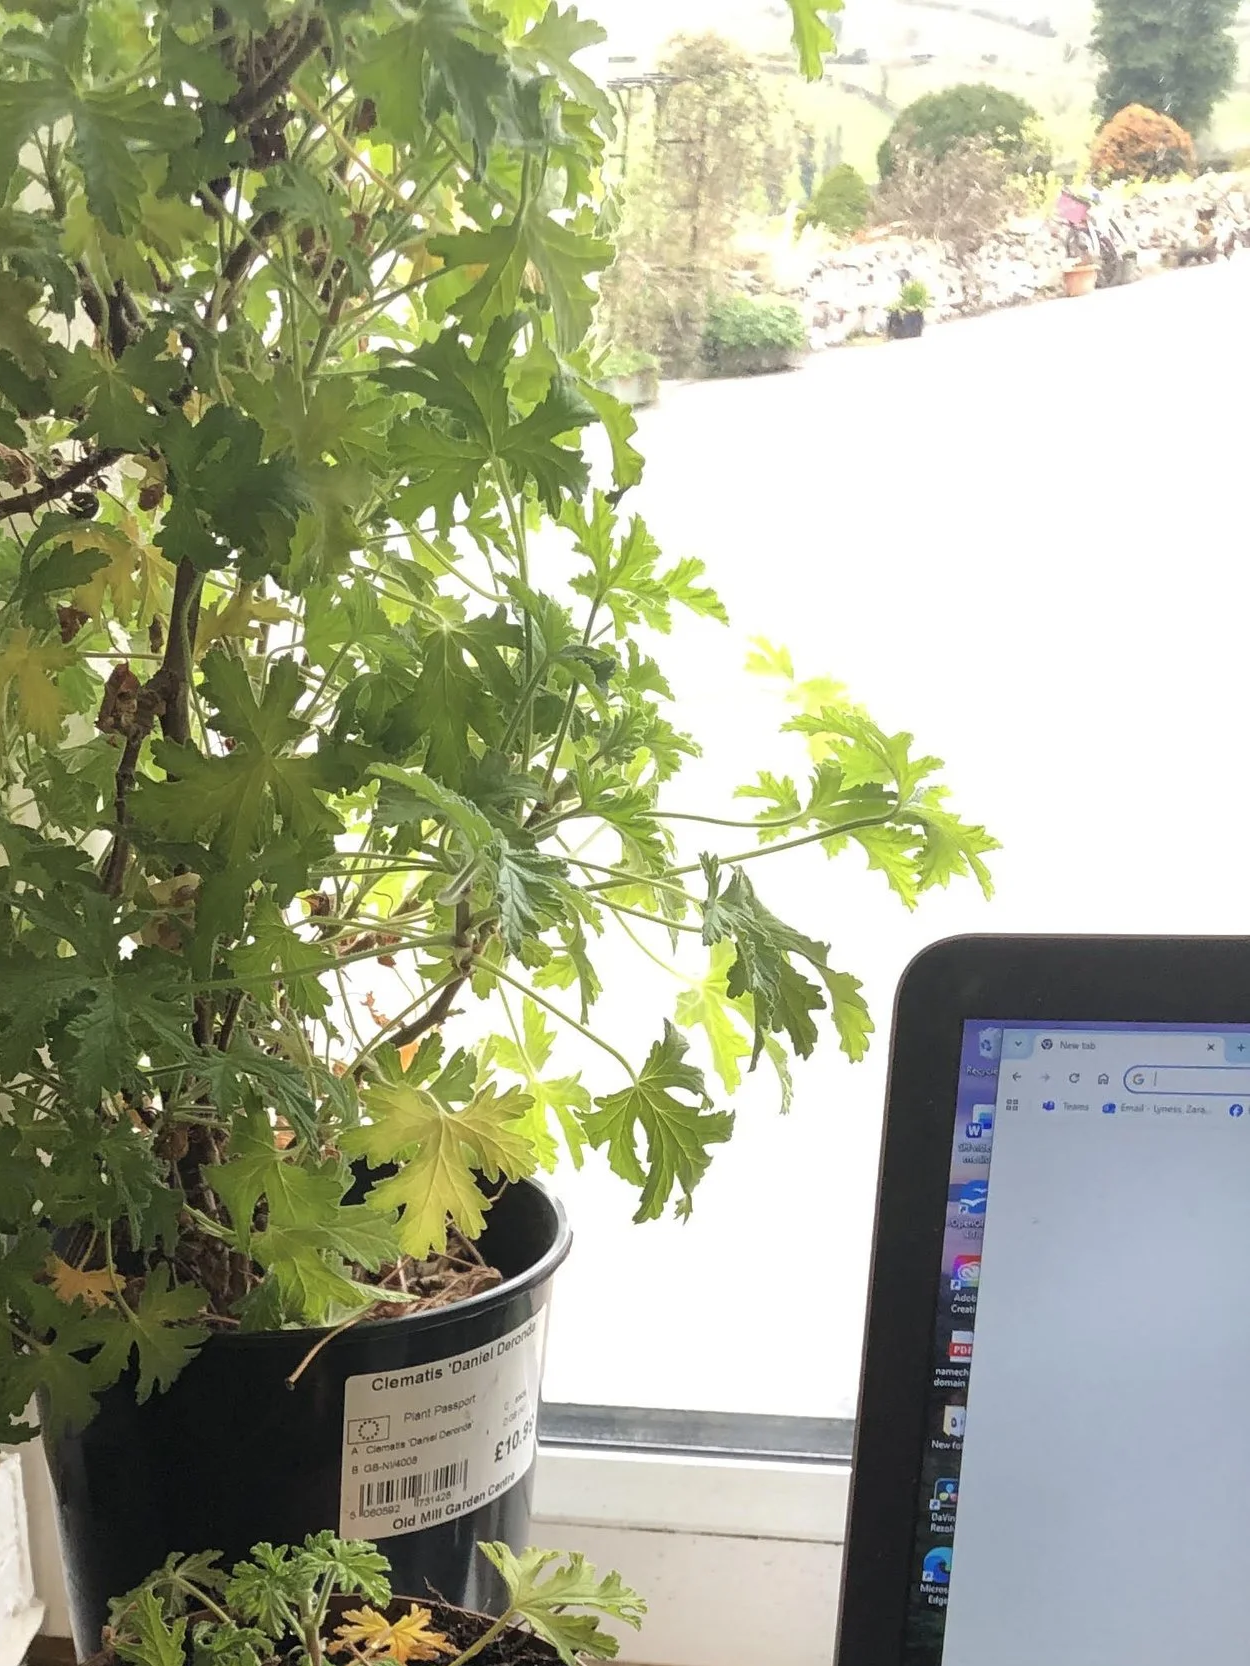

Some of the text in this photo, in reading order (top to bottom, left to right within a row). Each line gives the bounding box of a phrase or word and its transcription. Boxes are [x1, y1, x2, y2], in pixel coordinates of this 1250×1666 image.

[1063, 1102, 1090, 1112] Teams
[1121, 1103, 1144, 1113] Email
[371, 1367, 443, 1392] Clematis
[933, 1377, 966, 1387] domain
[403, 1394, 477, 1423] Plant Passport
[366, 1441, 406, 1455] Clematis
[931, 1440, 951, 1449] New
[392, 1471, 516, 1531] Old Mill Garden Centre
